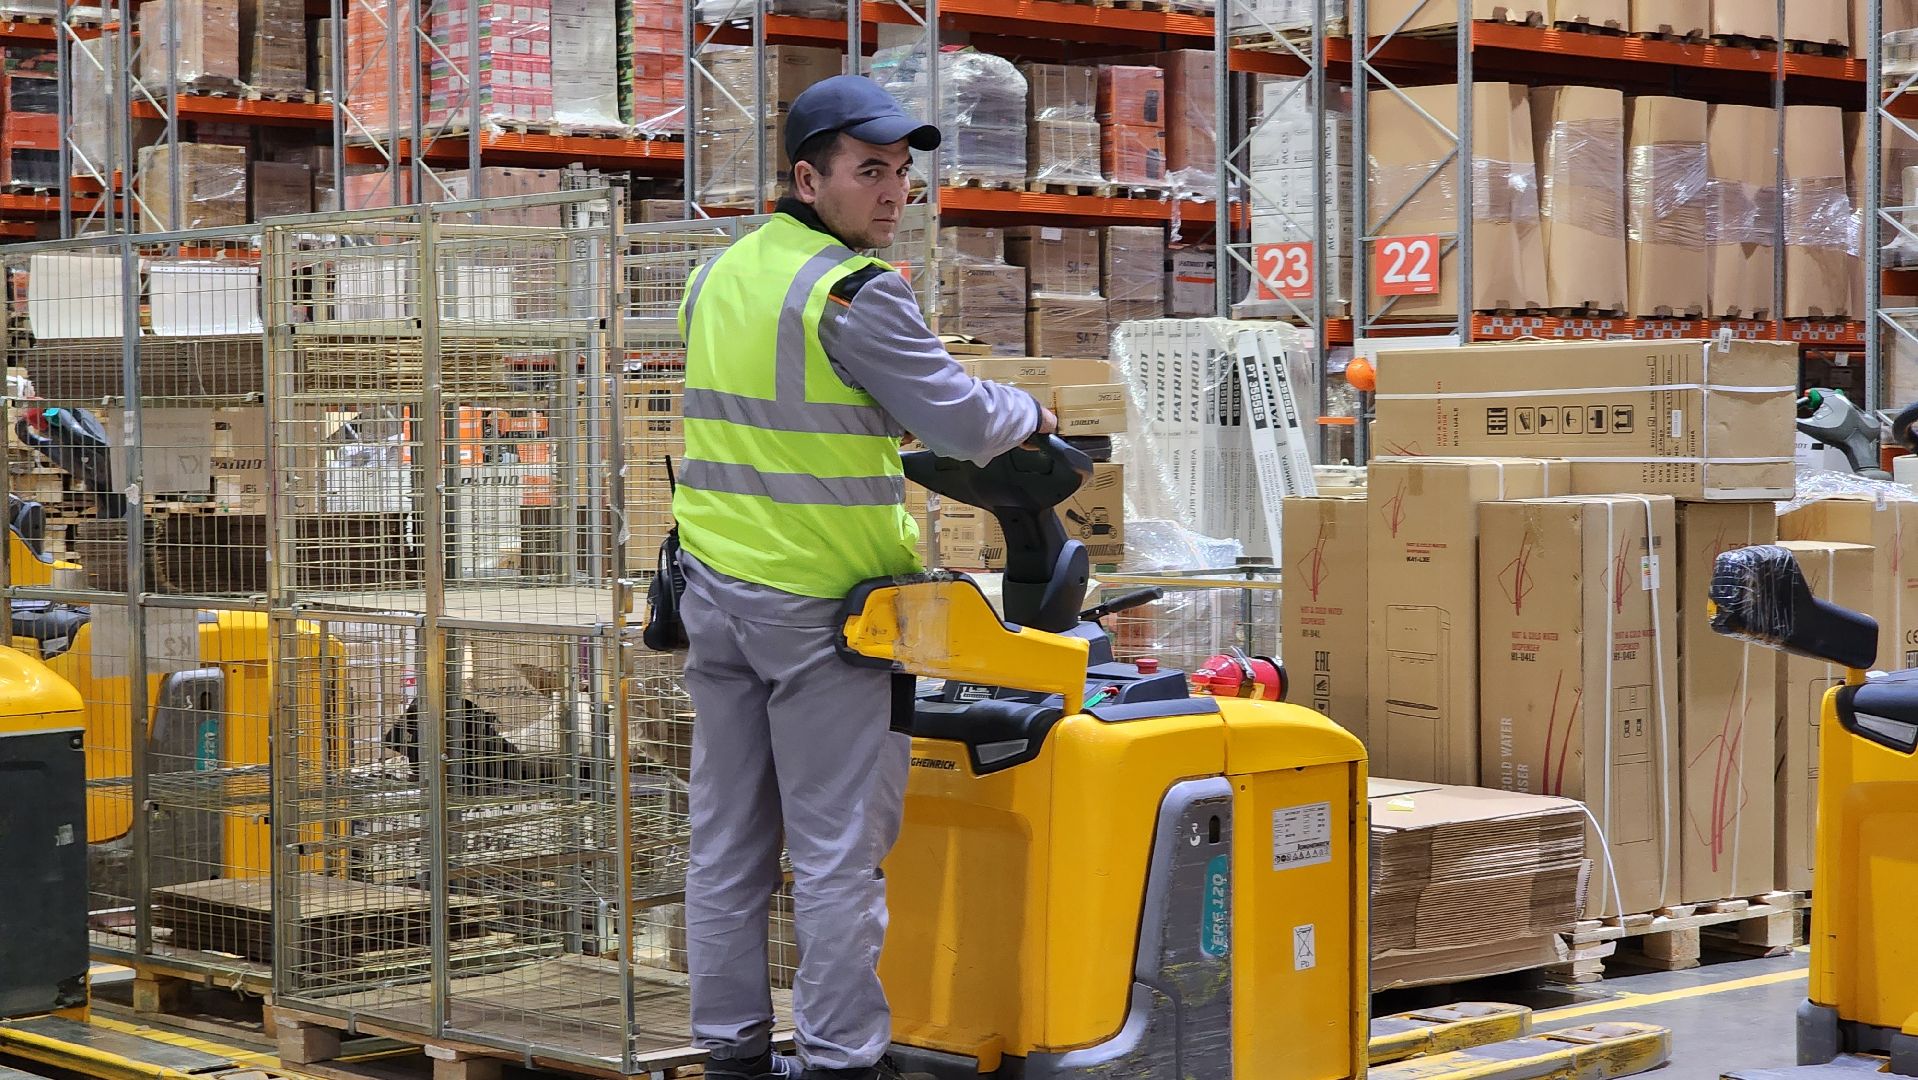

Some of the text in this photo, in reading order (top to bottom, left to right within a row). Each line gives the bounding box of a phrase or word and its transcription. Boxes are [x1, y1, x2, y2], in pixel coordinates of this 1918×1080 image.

[1263, 247, 1310, 289] 23
[1383, 240, 1431, 284] 22
[1077, 332, 1100, 344] SA 7
[1139, 351, 1149, 391] RIOT
[1156, 349, 1166, 422] PATRIOT
[1173, 349, 1182, 422] PATRIOT
[1190, 349, 1200, 422] PATRIOT
[1274, 363, 1295, 420] PT 3555ES
[1246, 363, 1265, 422] PT 3555ES
[1070, 418, 1100, 427] PATRIOT
[1487, 408, 1507, 434] EAC
[211, 458, 266, 470] PATRIO
[1189, 448, 1197, 497] ТРИММЕРА
[1314, 650, 1331, 672] EAC
[1500, 716, 1513, 757] WATER
[910, 757, 956, 770] GHEINRICH
[1517, 763, 1530, 792] NSER
[1211, 873, 1227, 947] ERE 120
